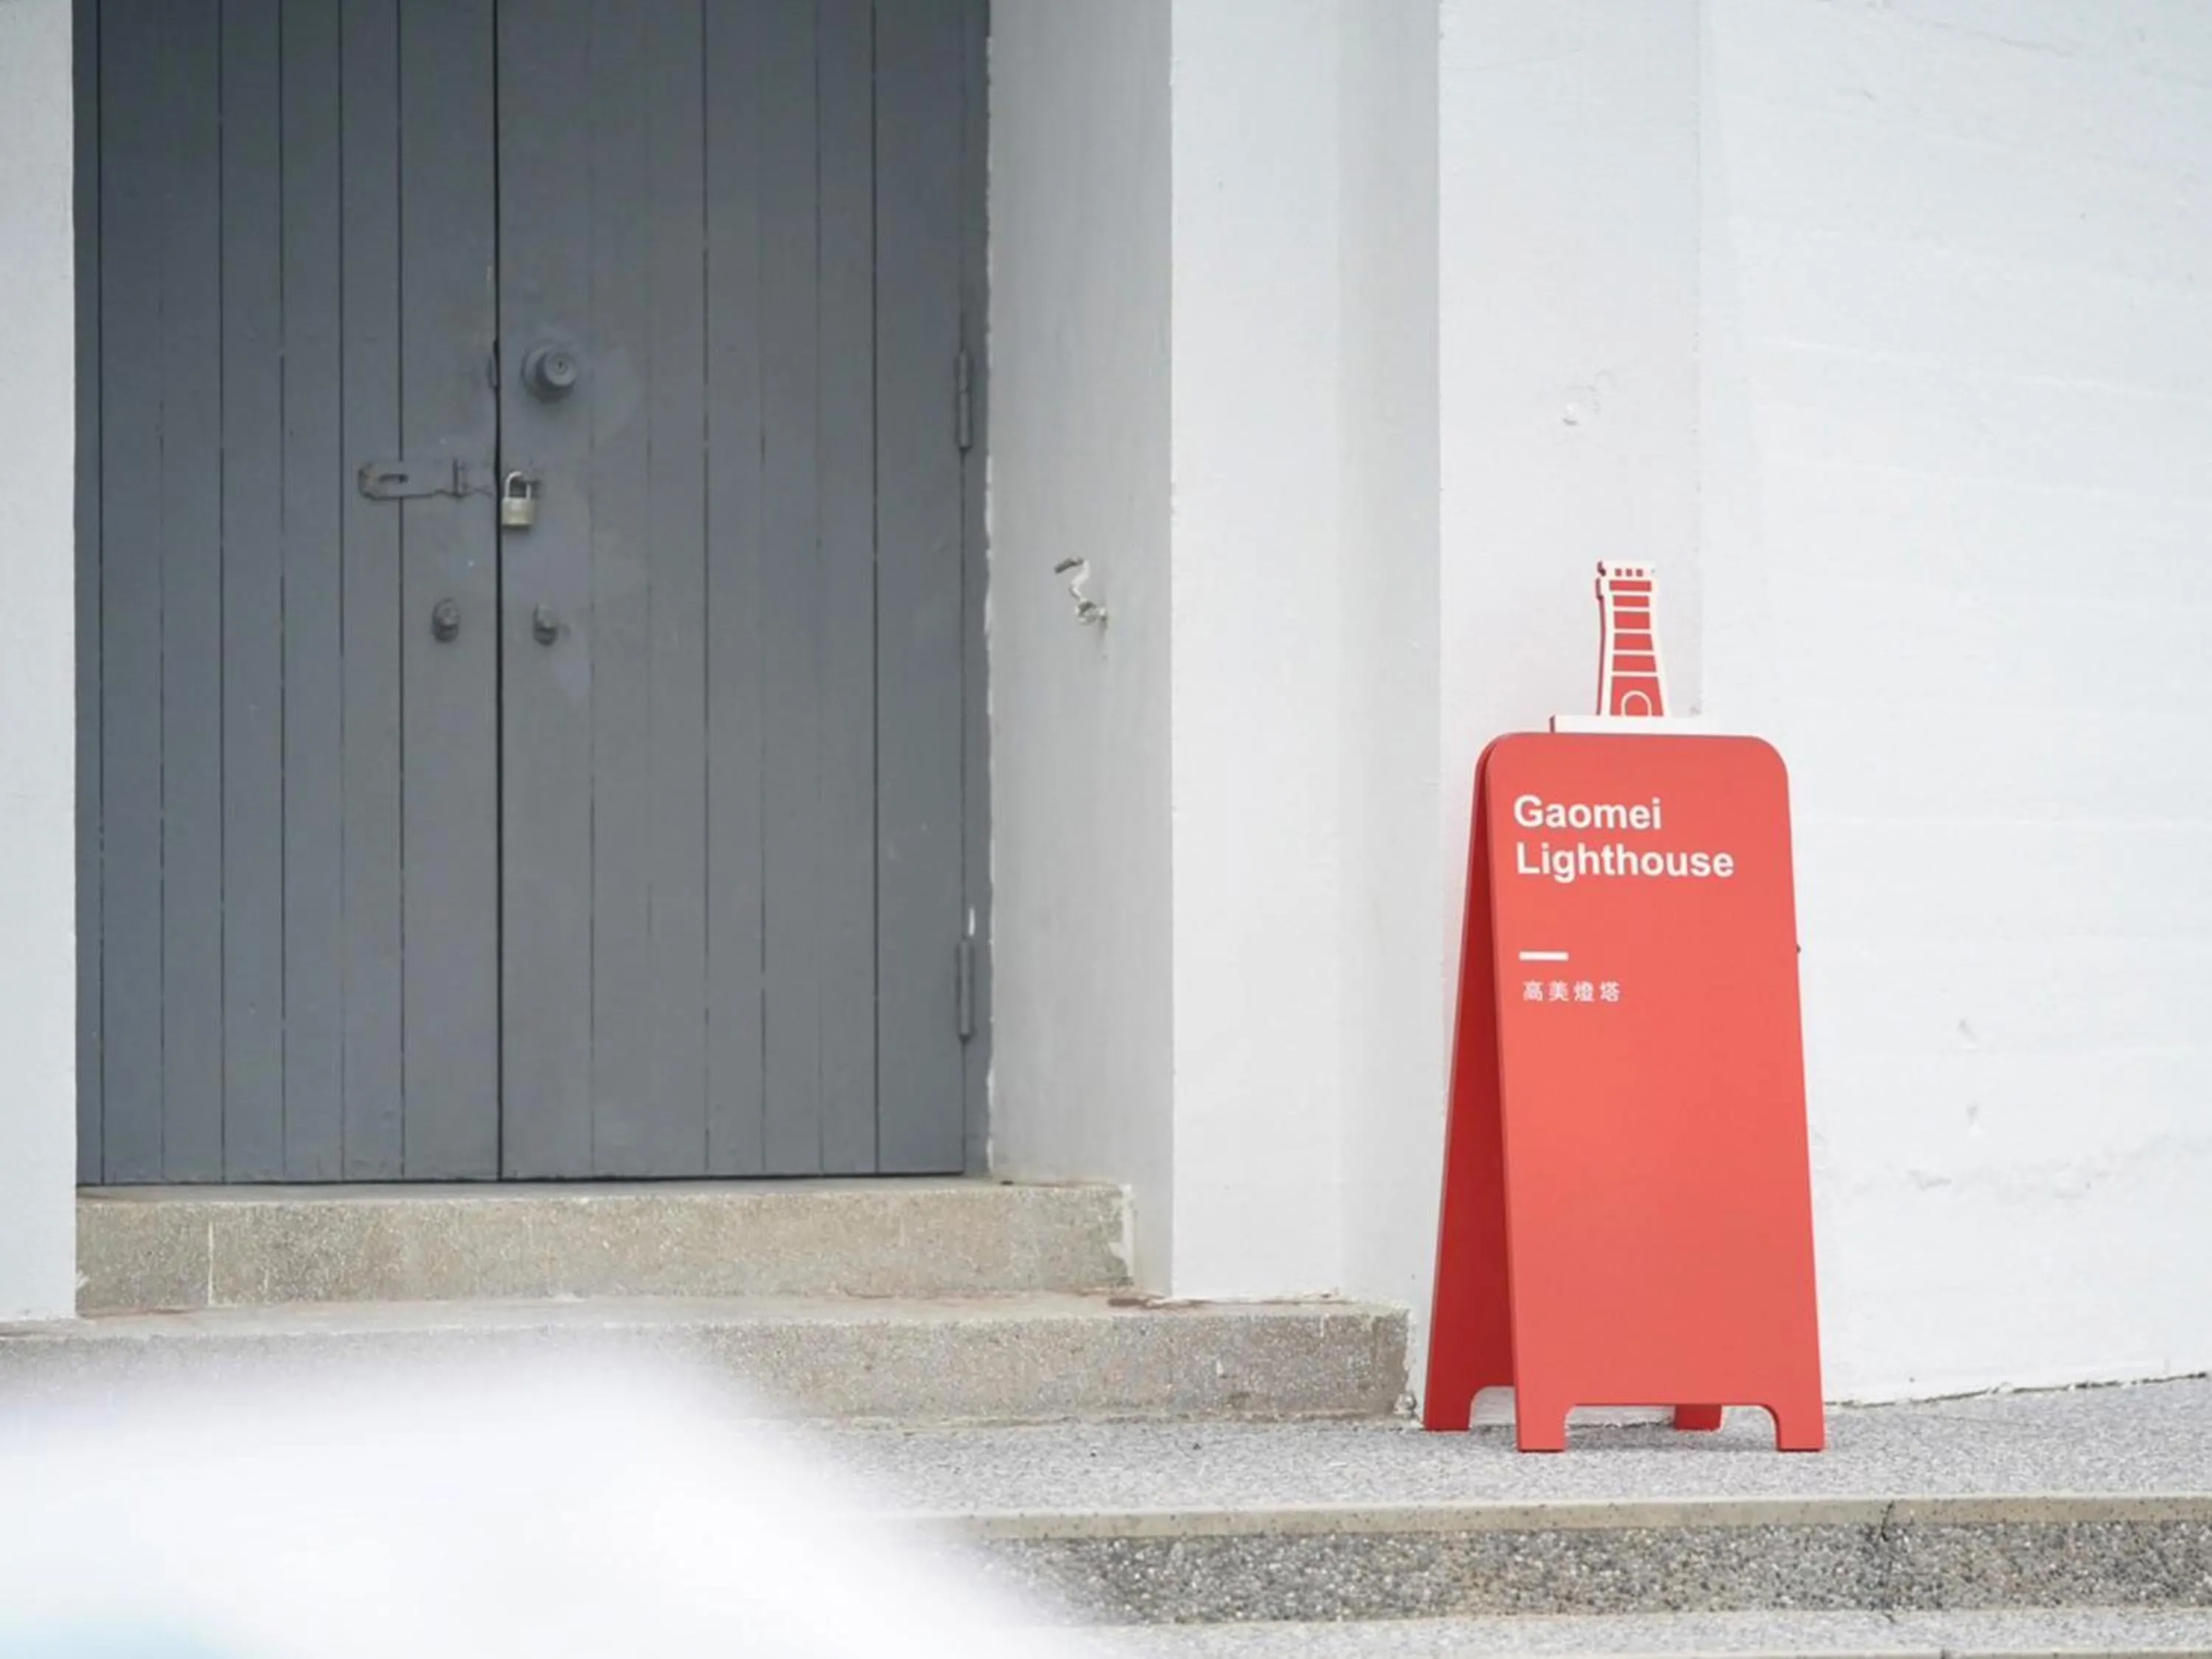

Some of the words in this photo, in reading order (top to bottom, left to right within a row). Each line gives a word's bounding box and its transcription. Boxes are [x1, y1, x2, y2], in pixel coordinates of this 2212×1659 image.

[1513, 794, 1662, 830] Gaomei
[1516, 841, 1735, 883] Lighthouse
[1523, 980, 1621, 1002] 高美燈塔
